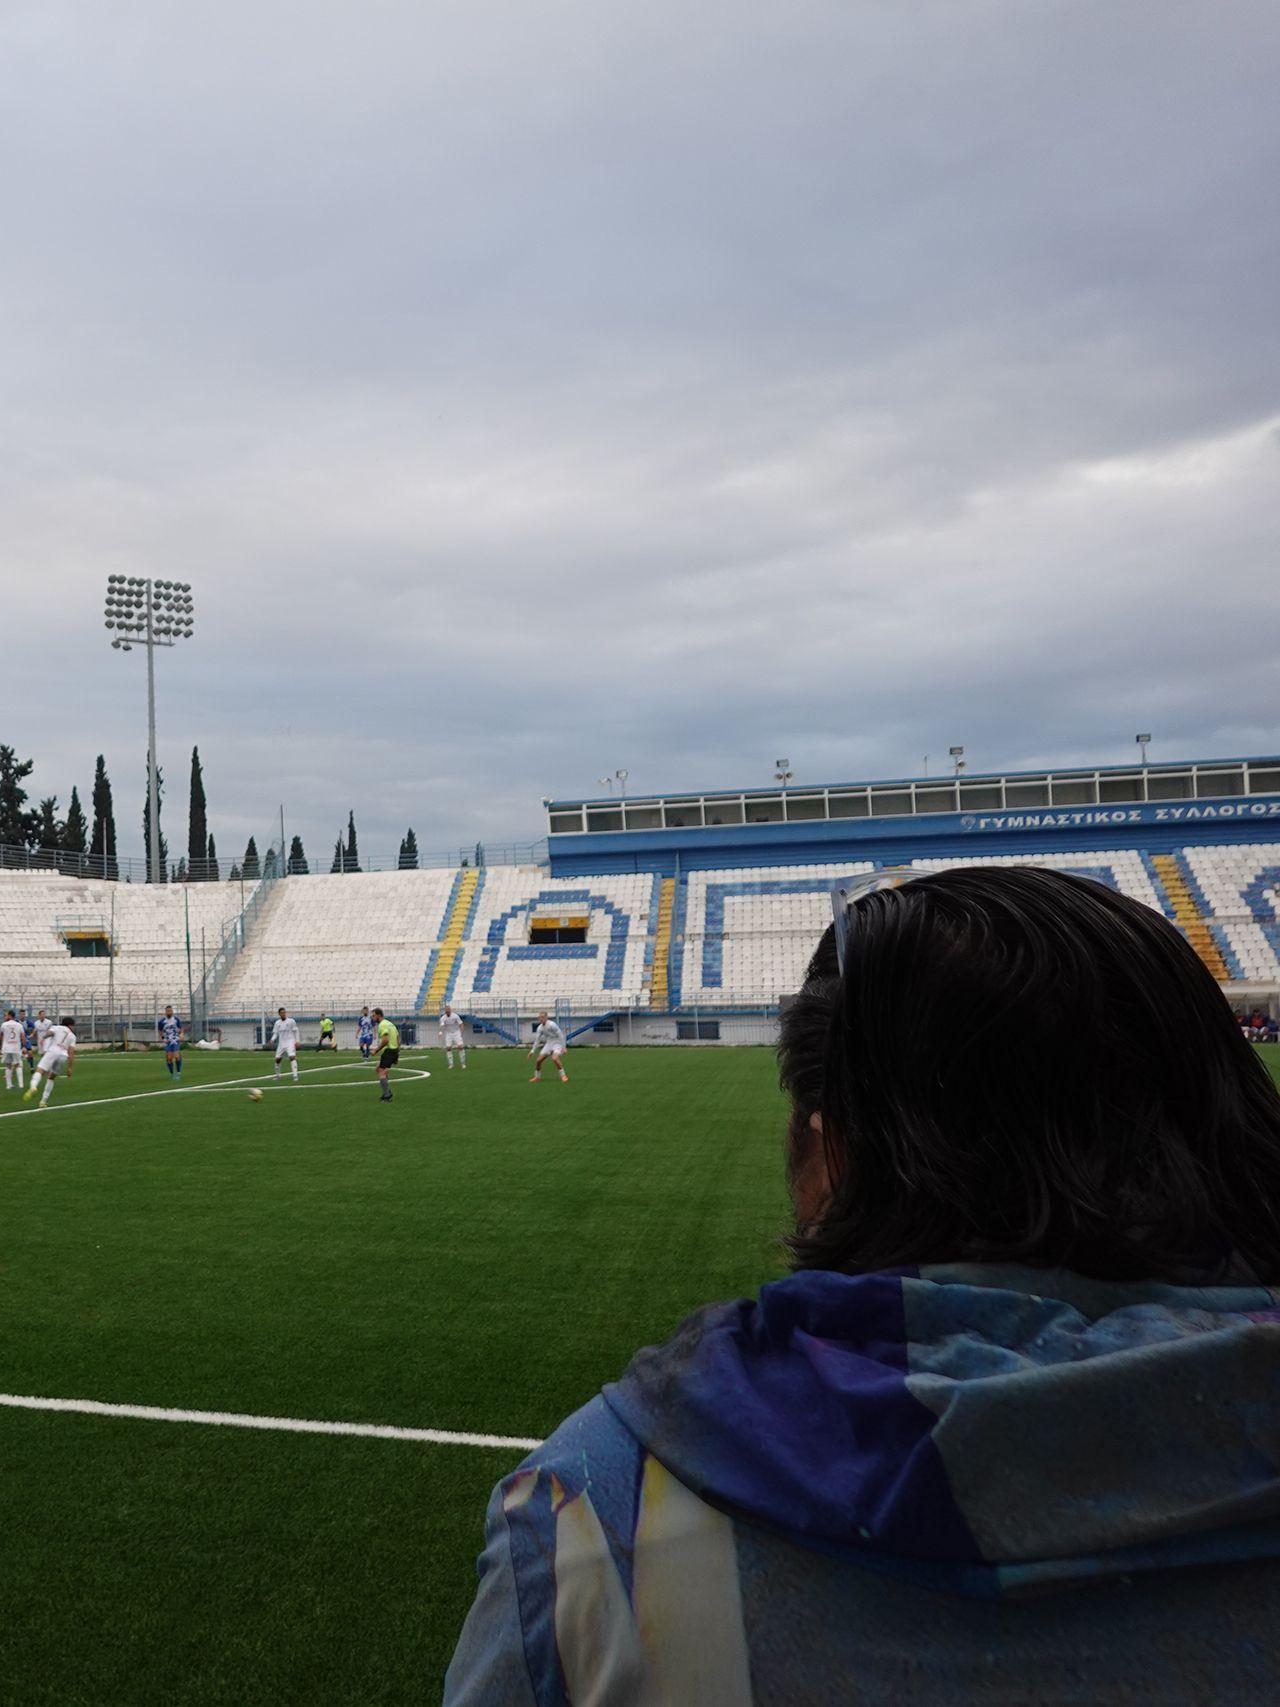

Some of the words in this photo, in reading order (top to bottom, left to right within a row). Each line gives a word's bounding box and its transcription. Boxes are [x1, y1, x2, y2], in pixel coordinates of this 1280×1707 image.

[979, 809, 1142, 829] ΓΥΜΝΑΣΤΙΚΟΣ
[1154, 803, 1280, 820] ΣΥΛΛΟΓΟΣ
[9, 1027, 17, 1040] 3
